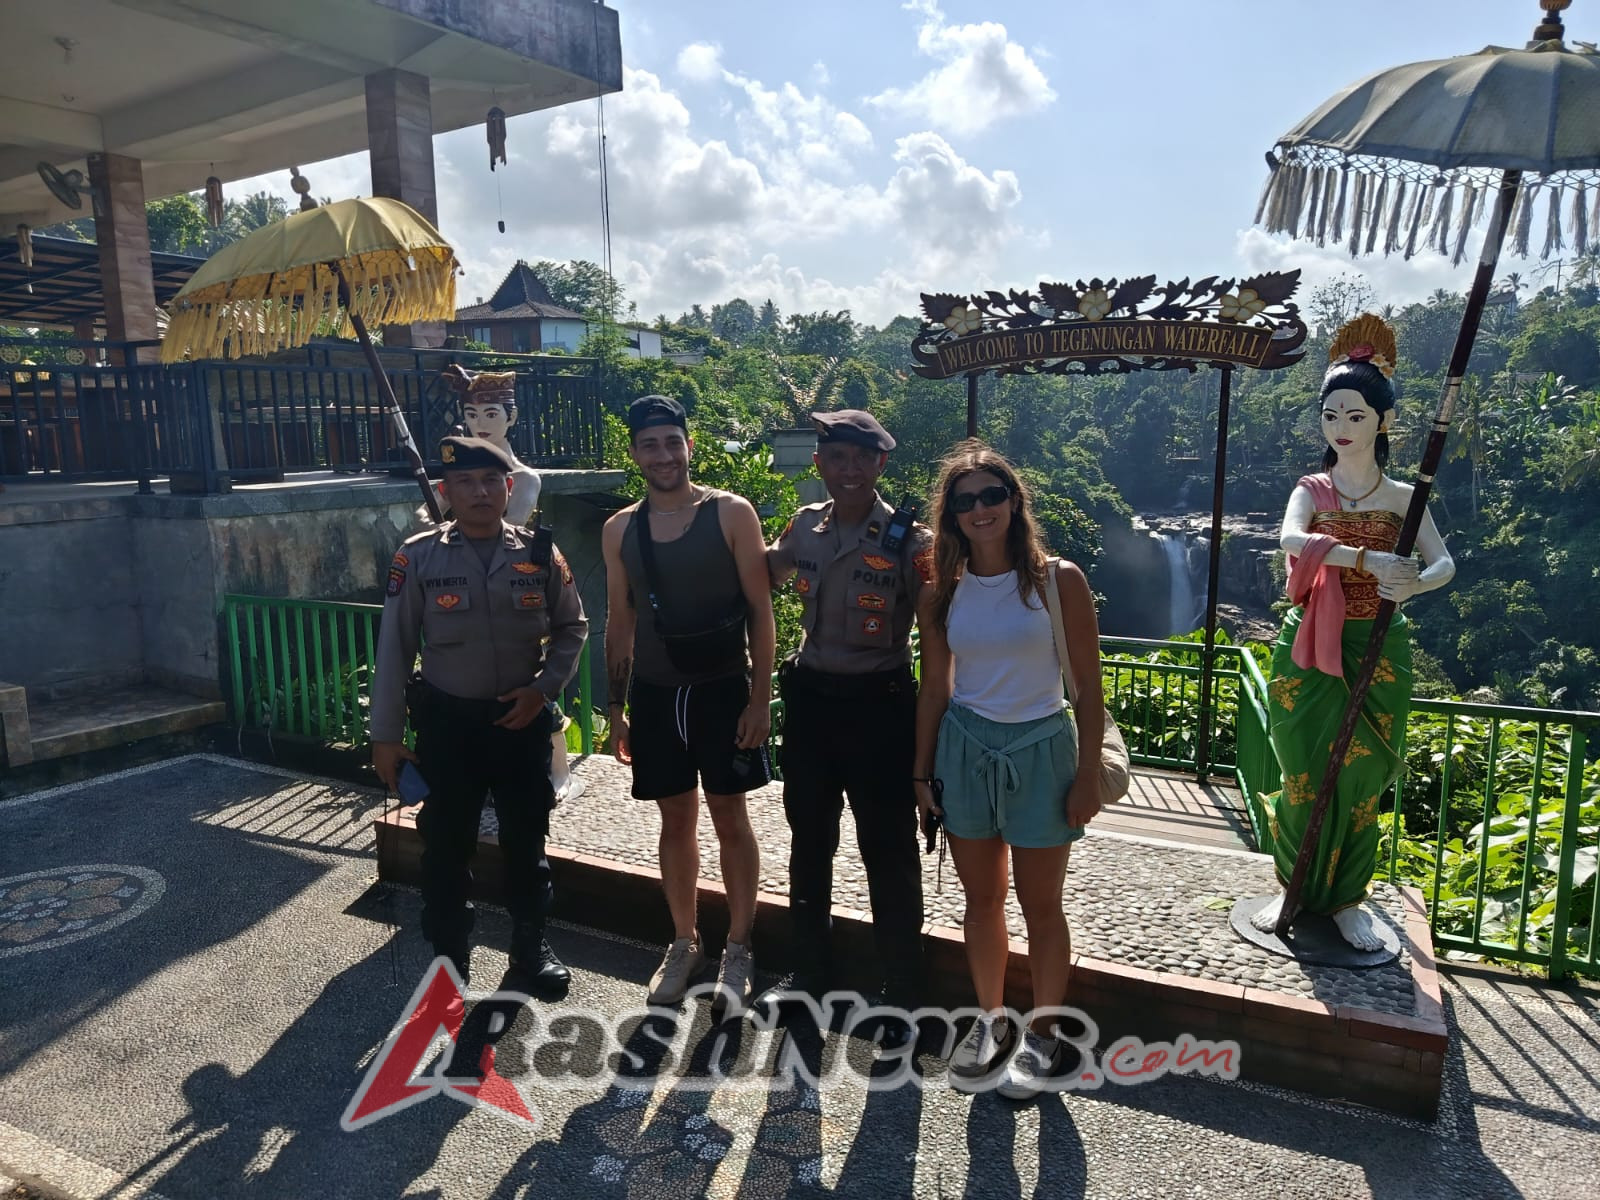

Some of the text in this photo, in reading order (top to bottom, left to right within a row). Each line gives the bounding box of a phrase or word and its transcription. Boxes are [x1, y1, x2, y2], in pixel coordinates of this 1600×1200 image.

[944, 325, 1260, 370] WELCOME TO TEGENUNGAN WATERFALL
[853, 569, 896, 588] POLRI
